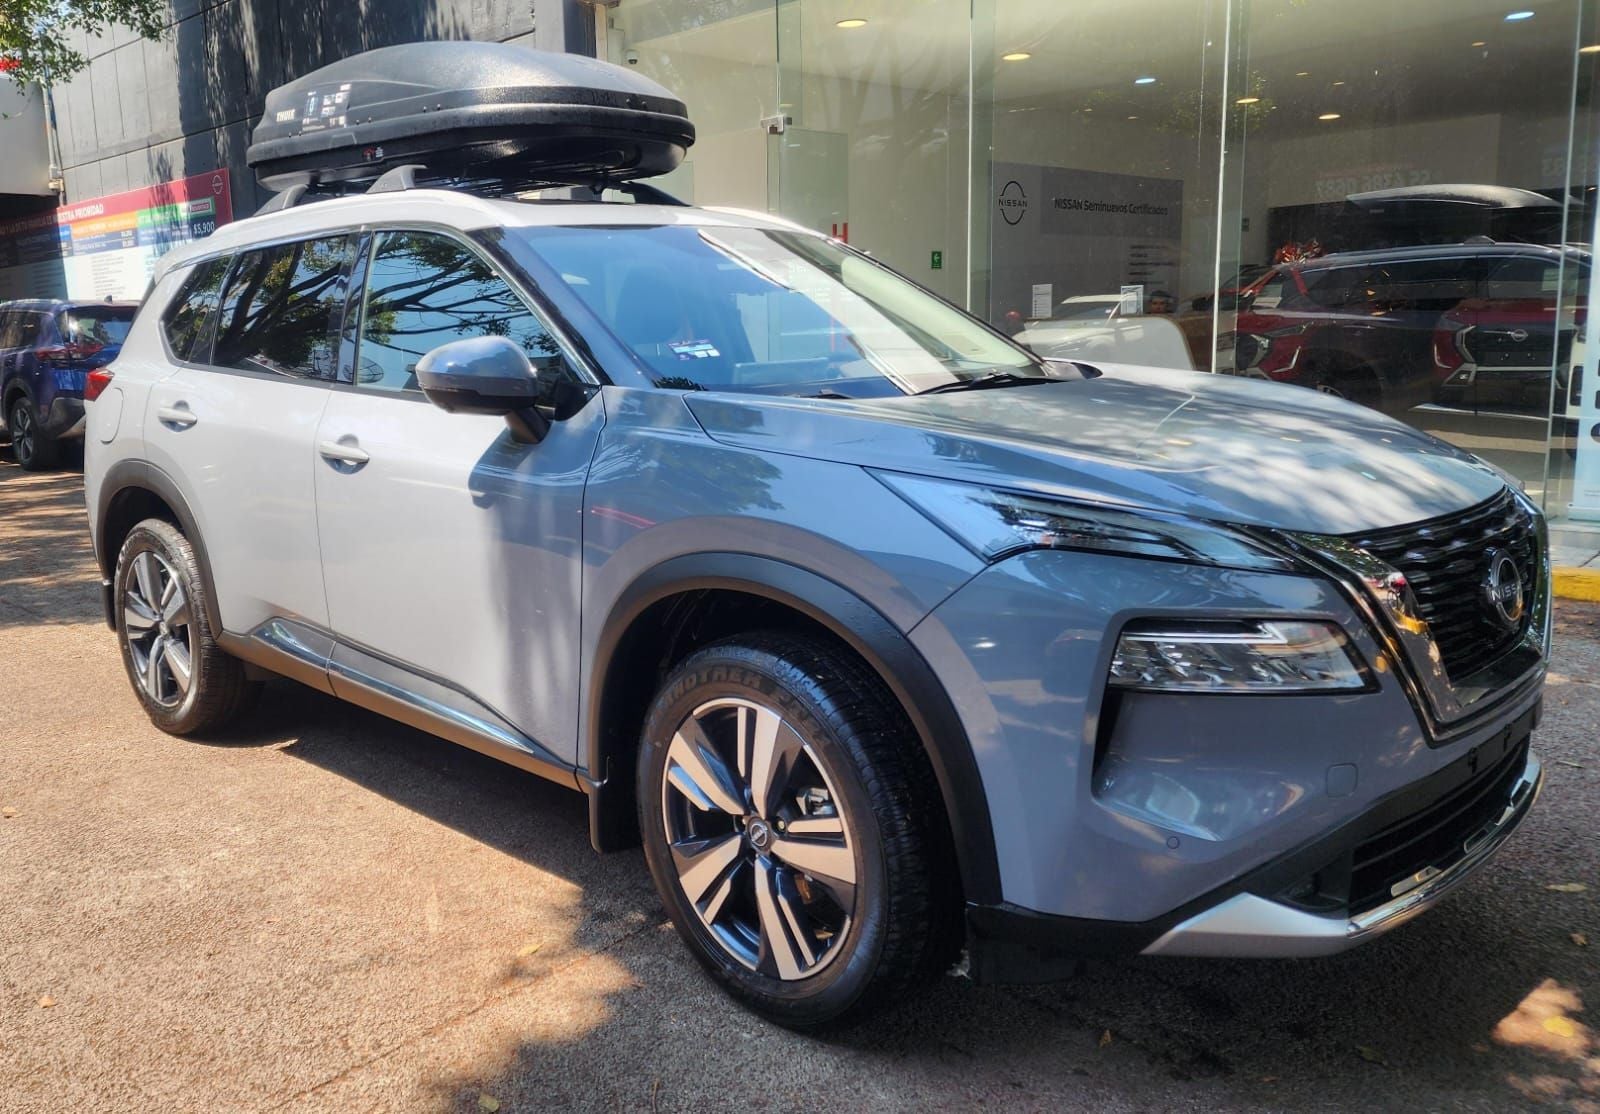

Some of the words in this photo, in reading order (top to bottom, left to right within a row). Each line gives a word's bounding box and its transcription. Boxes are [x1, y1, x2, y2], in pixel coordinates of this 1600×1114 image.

[999, 199, 1027, 207] NISSAN
[1055, 199, 1082, 210] NISSAN
[1084, 201, 1127, 214] Seminuevos
[1129, 203, 1168, 216] Certificados
[74, 203, 104, 218] PRIORIDAD
[193, 221, 214, 234] $5,900
